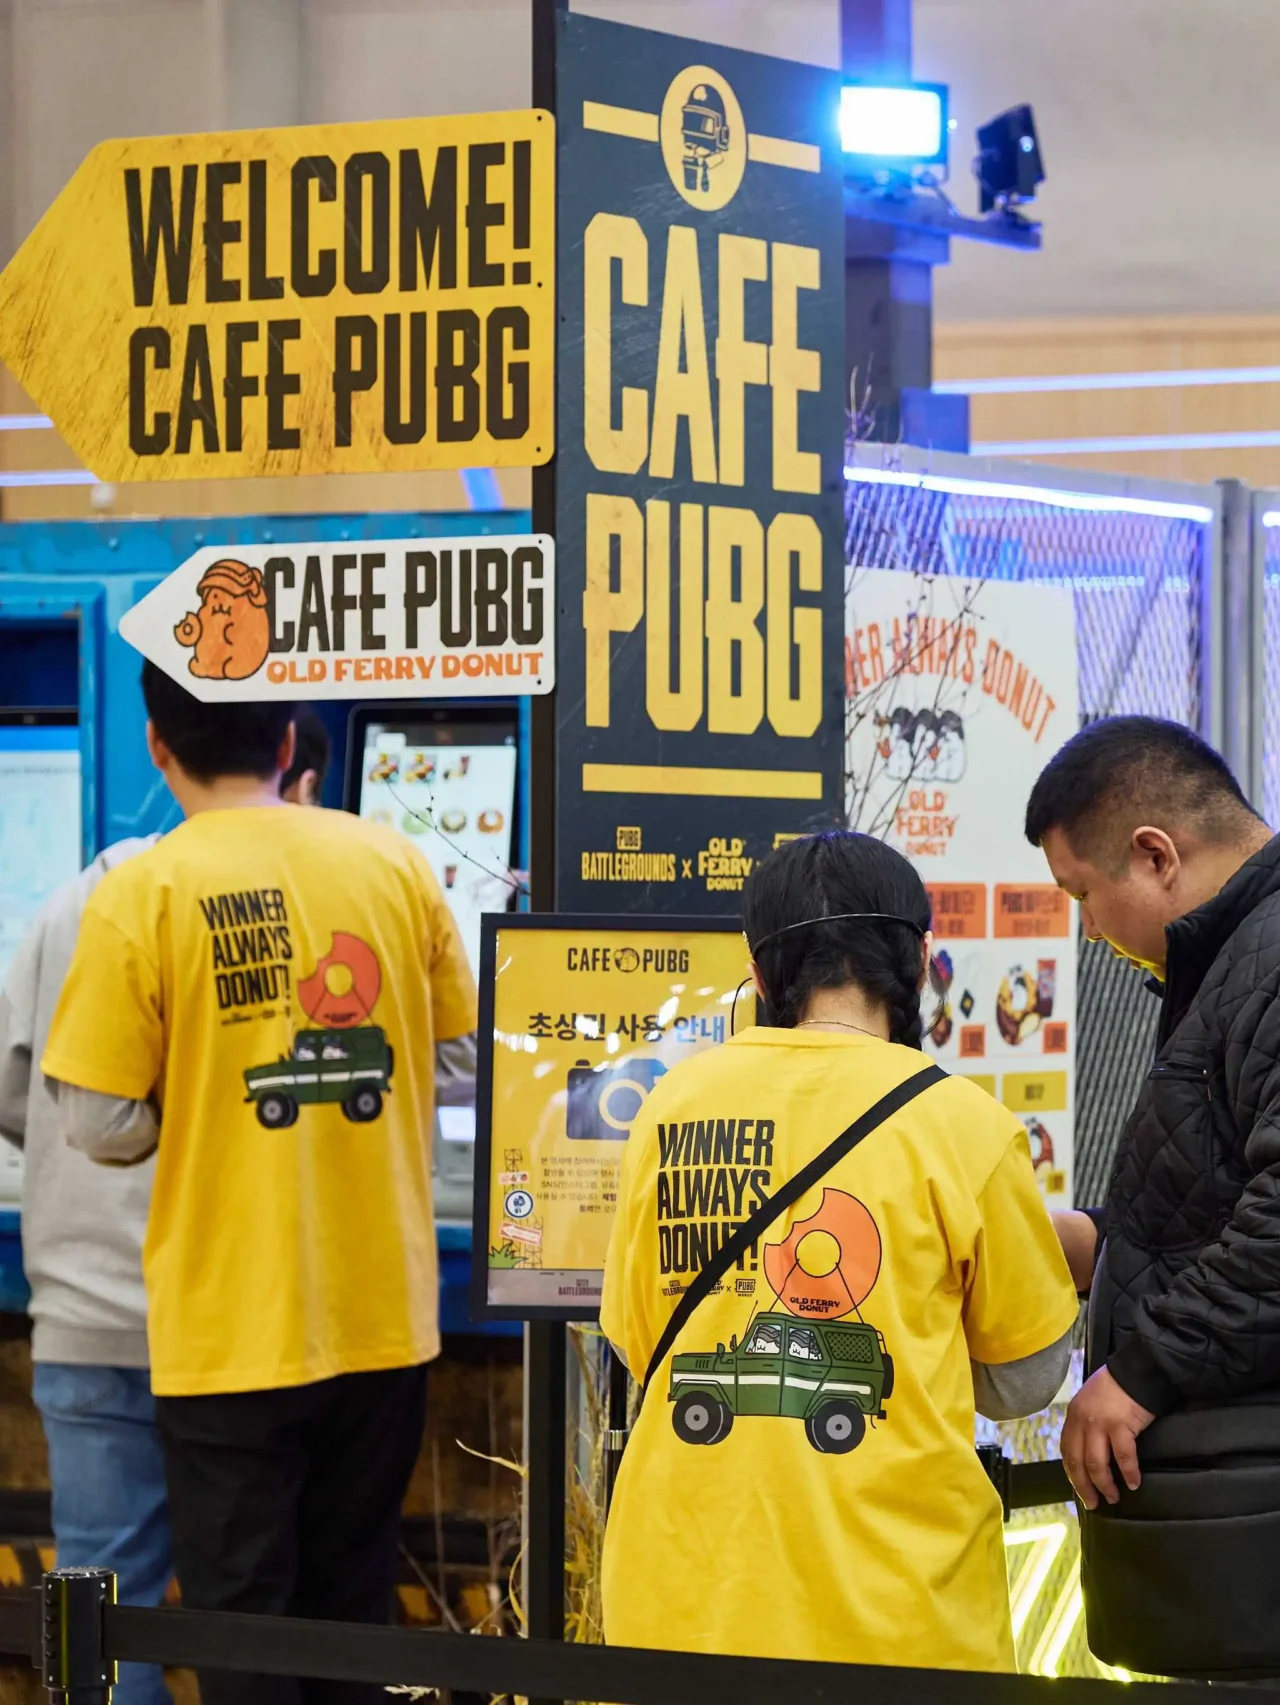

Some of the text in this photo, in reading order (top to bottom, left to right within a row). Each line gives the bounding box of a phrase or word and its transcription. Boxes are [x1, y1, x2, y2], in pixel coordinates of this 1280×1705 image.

[124, 140, 531, 307] WELCOME!
[584, 212, 821, 495] CAFE
[129, 306, 530, 456] CAFE PUBG
[264, 546, 543, 653] CAFE PUBG
[583, 492, 822, 738] PUBG
[266, 652, 544, 684] OLD FERRY DONUT
[982, 638, 1056, 744] DONUT
[909, 790, 944, 811] OLD
[896, 807, 956, 837] FERRY
[617, 828, 640, 848] PUBG
[709, 837, 744, 857] OLD
[581, 852, 676, 882] BATTLEGROUNDS
[698, 851, 753, 876] FERRY
[706, 877, 745, 891] DONUT
[199, 889, 288, 931] WINNER
[213, 926, 292, 970] ALWAYS
[567, 948, 690, 974] CAFE PUBG
[616, 1013, 666, 1042] 사용
[674, 1015, 725, 1044] 안내
[657, 1119, 775, 1168] WINNER
[657, 1168, 771, 1221] ALWAYS
[739, 1281, 754, 1291] PUBG
[799, 1304, 829, 1313] DONUT
[810, 1299, 840, 1308] FERRY
